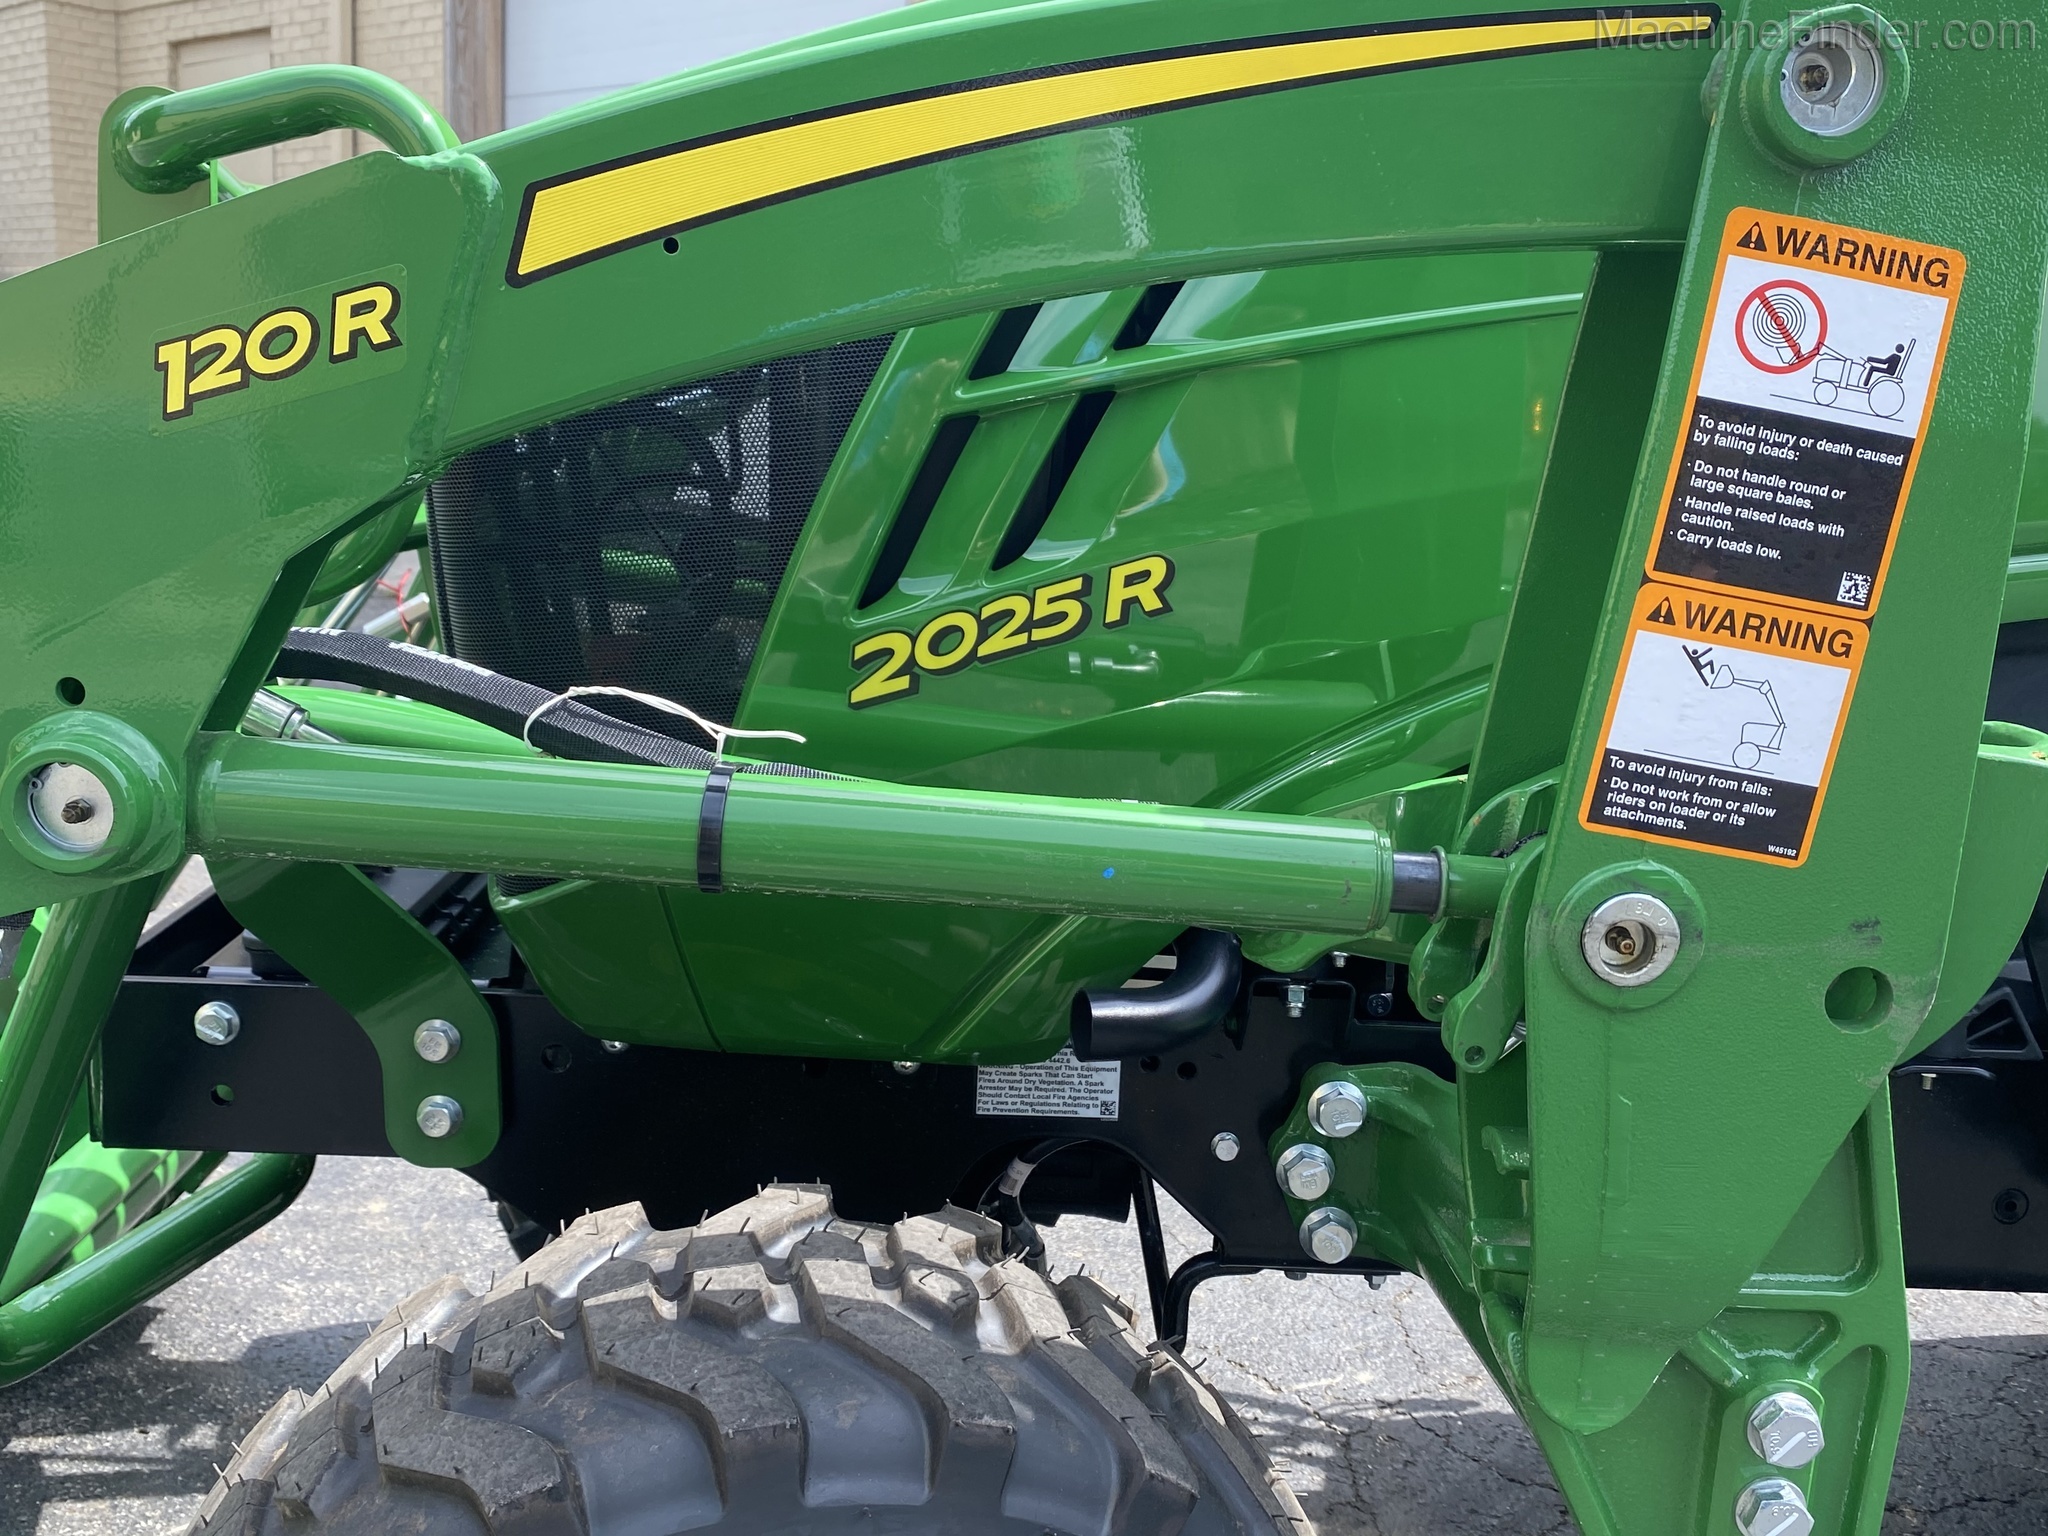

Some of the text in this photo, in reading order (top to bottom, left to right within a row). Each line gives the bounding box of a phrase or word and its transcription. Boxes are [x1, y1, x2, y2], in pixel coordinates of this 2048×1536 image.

[1776, 225, 1949, 289] WARNING
[155, 281, 403, 421] 120 R
[1694, 429, 1799, 460] by falling loads:
[1699, 415, 1904, 466] To avoid injury or death caused
[1690, 474, 1814, 509] large square bales.
[1694, 460, 1846, 499] Do not handle round or
[1681, 513, 1734, 531] caution.
[1685, 496, 1844, 537] Handle raised loads with
[1677, 529, 1781, 559] Carry loads low.
[849, 552, 1175, 710] 2025 R
[1685, 600, 1854, 658] WARNING
[1610, 756, 1772, 796] To avoid injury from falls:
[1607, 791, 1745, 826] riders on loader or its
[1610, 777, 1776, 817] Do not work from or allow
[1603, 805, 1687, 830] attachments.
[978, 1069, 993, 1077] May
[1024, 1078, 1037, 1086] Dry
[1080, 1065, 1117, 1073] Equipment
[1019, 1100, 1061, 1108] Regulations
[1062, 1101, 1090, 1109] Relating
